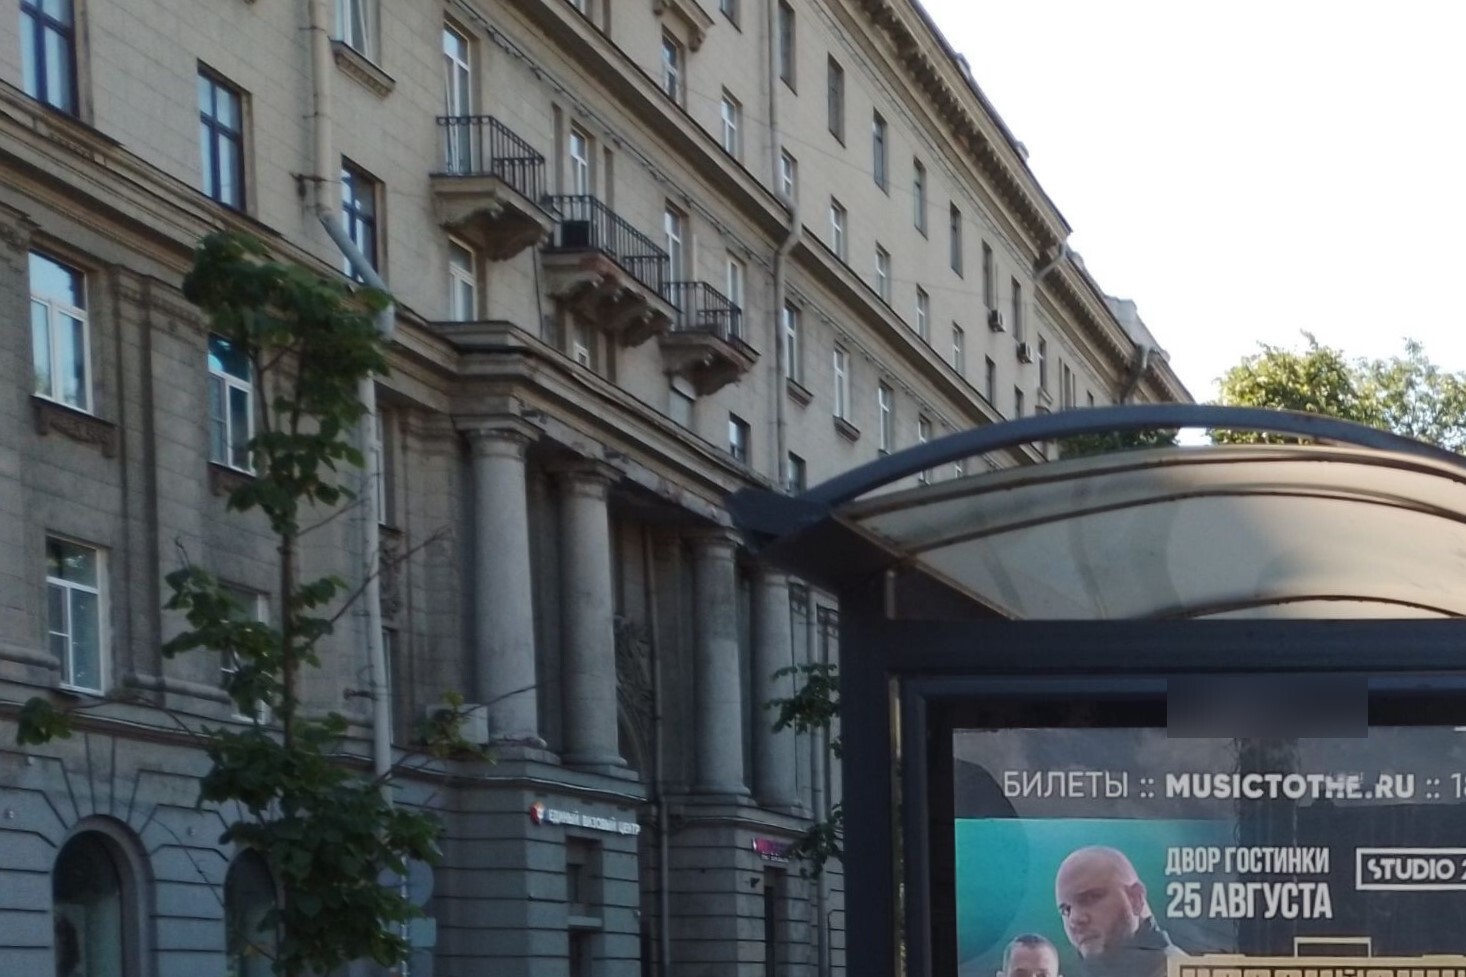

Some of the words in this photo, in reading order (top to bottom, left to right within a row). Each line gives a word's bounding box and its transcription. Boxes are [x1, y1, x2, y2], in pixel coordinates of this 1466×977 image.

[1004, 770, 1128, 799] БИЛЕТЫ
[1165, 772, 1415, 799] MUSICTOTHE.RU
[1164, 846, 1222, 876] ДВОР
[1225, 846, 1330, 874] ГОСТИНКИ
[1367, 858, 1455, 881] STUDIO
[1166, 881, 1202, 918] 25
[1208, 882, 1333, 919] АВГУСТА
